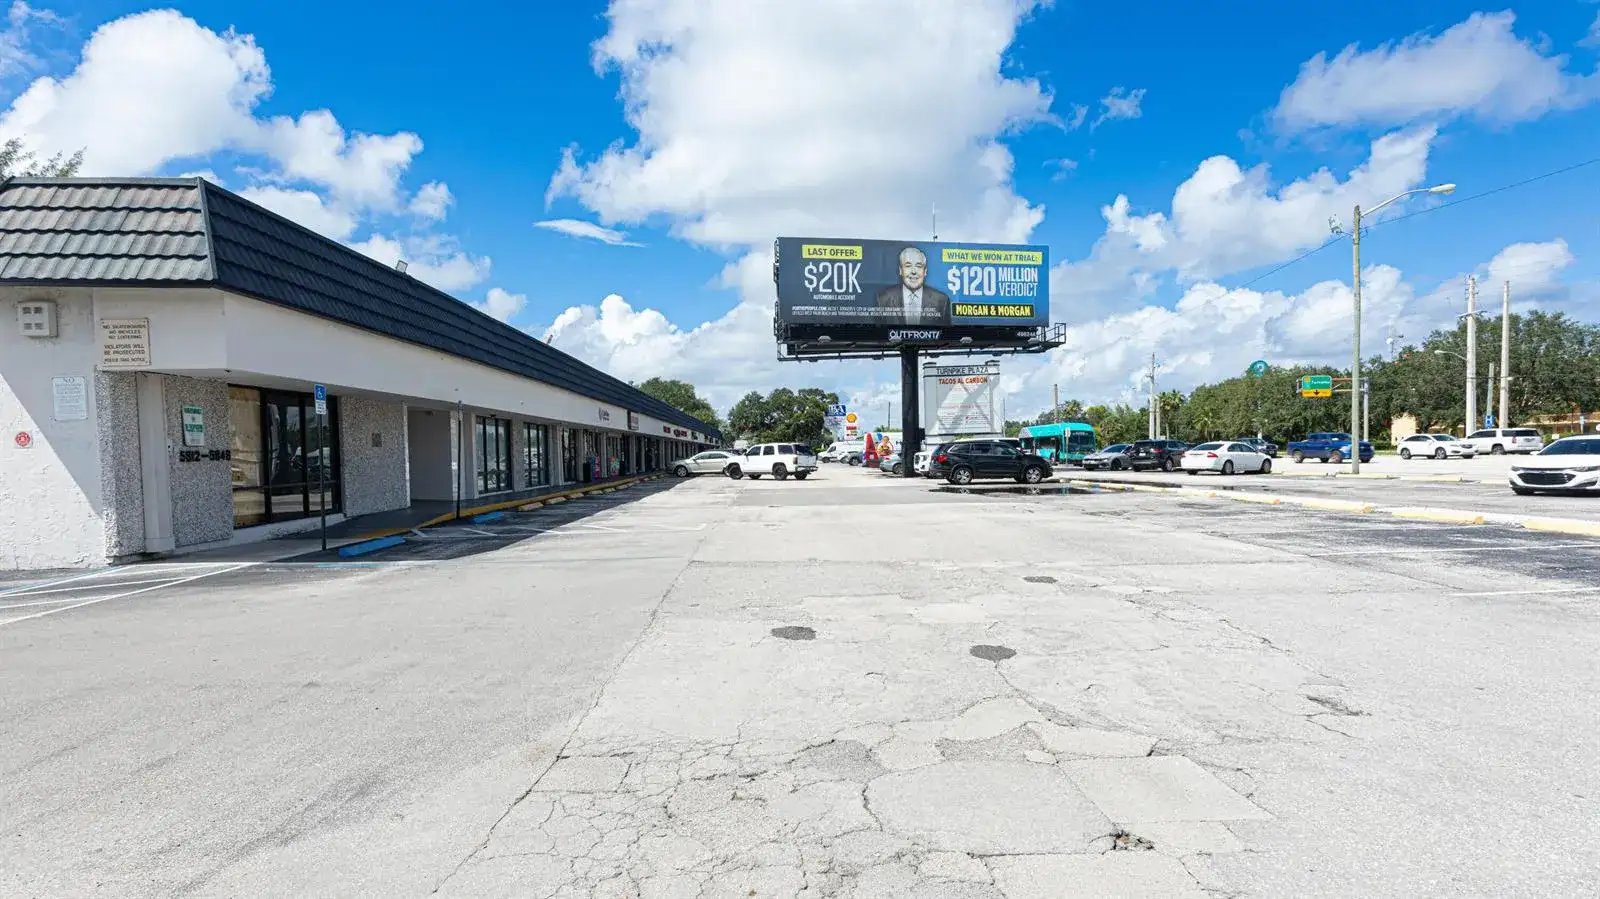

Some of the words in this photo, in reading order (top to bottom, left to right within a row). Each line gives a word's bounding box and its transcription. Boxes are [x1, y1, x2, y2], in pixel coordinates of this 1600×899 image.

[807, 248, 827, 256] LAST
[829, 248, 858, 257] OFFER:
[947, 252, 968, 260] WHAT
[984, 253, 1001, 261] WON
[1015, 254, 1038, 262] TRIAL:
[804, 262, 862, 293] $20K
[947, 265, 996, 296] $120
[998, 267, 1038, 282] MILLION
[998, 282, 1038, 297] VERDICT
[955, 304, 988, 316] MORGAN
[990, 305, 997, 315] &
[998, 305, 1031, 316] MORGAN
[936, 367, 966, 375] TURNPIKE
[967, 366, 989, 374] PLAZA
[965, 376, 988, 384] CARBON
